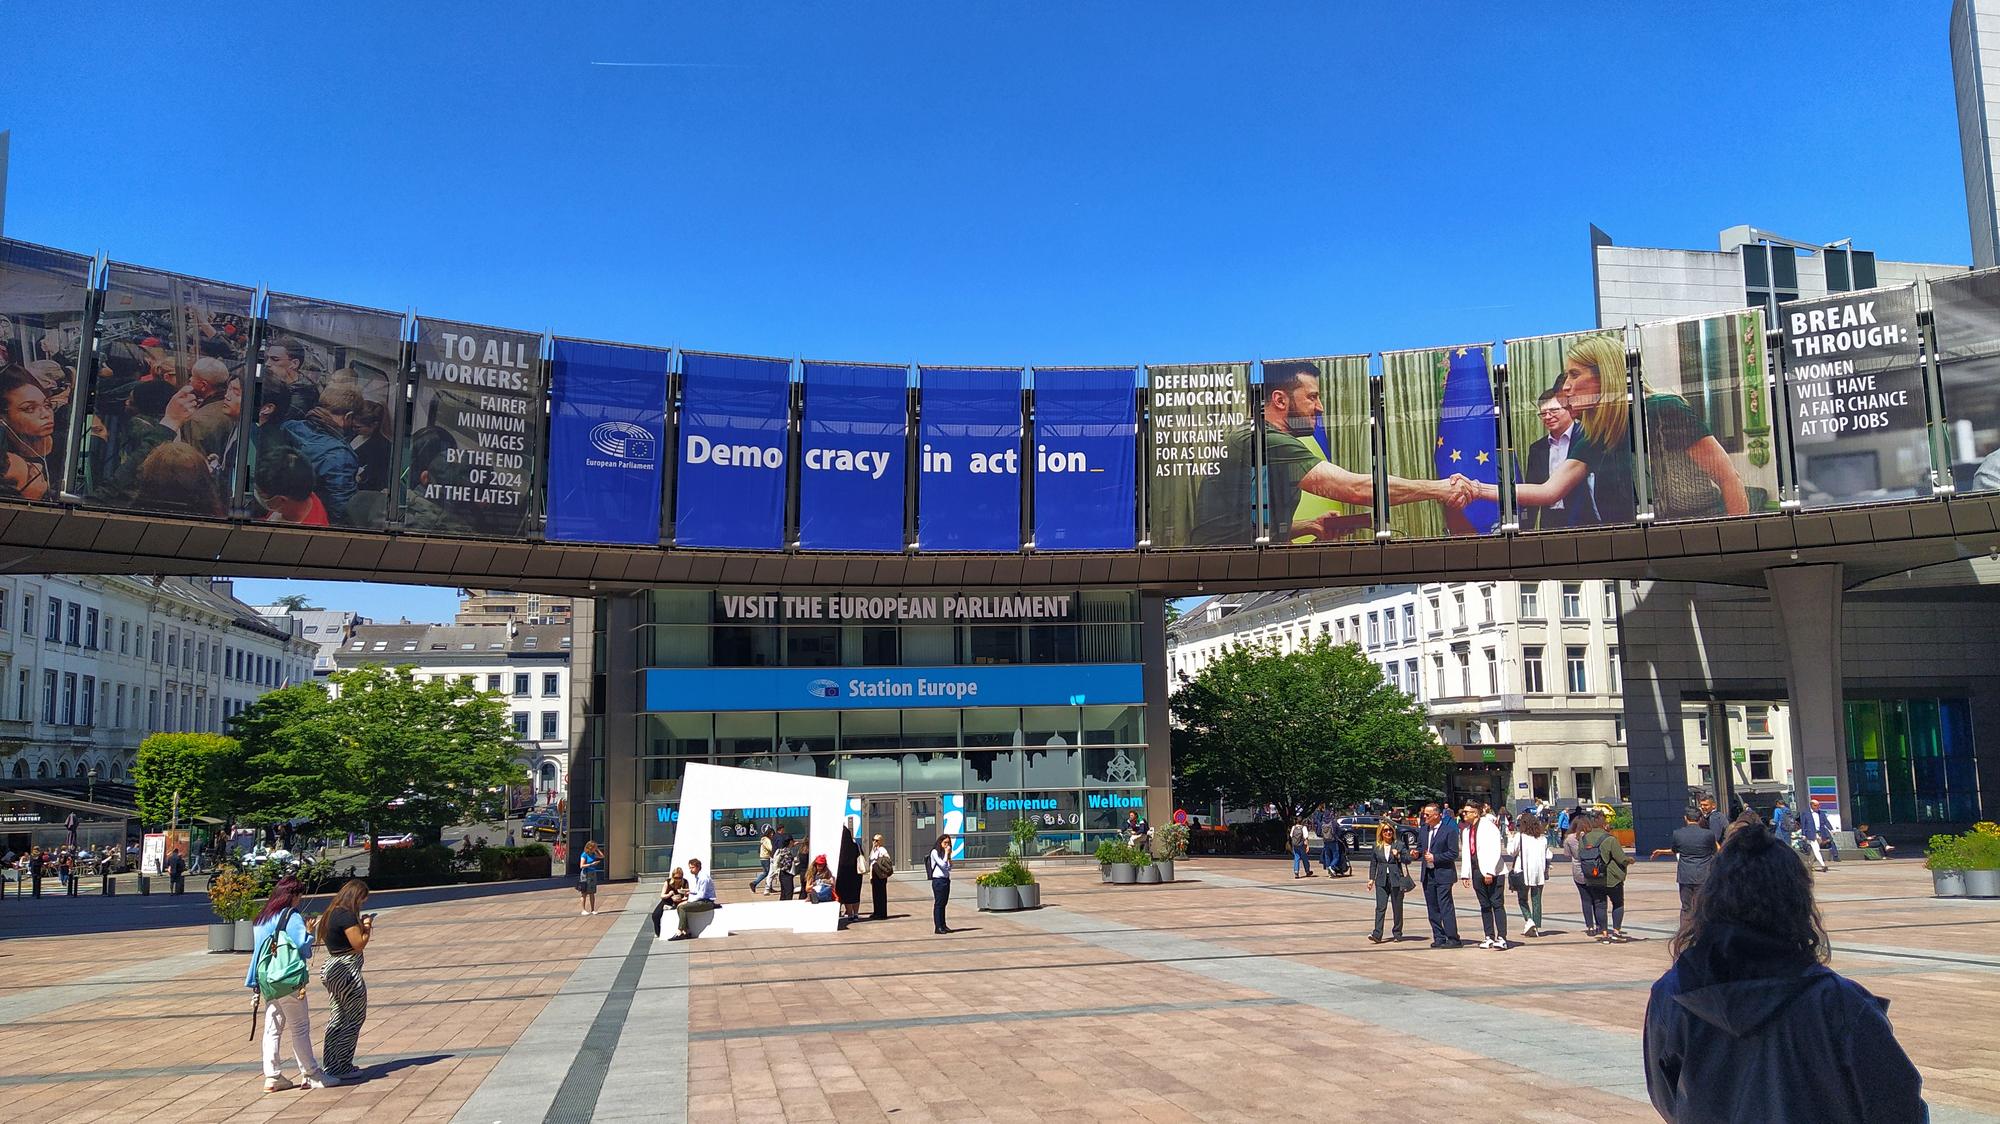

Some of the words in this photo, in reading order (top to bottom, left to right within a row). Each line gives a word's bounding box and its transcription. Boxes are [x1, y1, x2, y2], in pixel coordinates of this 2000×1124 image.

[1790, 301, 1877, 336] BREAK
[441, 333, 476, 362] TO
[482, 339, 529, 369] ALL
[1791, 324, 1907, 358] THROUGH:
[425, 360, 529, 392] WORKERS:
[1155, 373, 1234, 389] DEFENDING
[1794, 359, 1854, 381] WOMEN
[1155, 390, 1246, 407] DEMOCRACY:
[1796, 381, 1834, 400] WILL
[1836, 375, 1877, 395] HAVE
[480, 395, 527, 415] FAIRER
[1799, 403, 1810, 418] A
[1812, 398, 1846, 416] FAIR
[1848, 390, 1908, 412] CHANCE
[457, 411, 525, 433] MINIMUM
[1155, 414, 1173, 428] WE
[1175, 413, 1204, 427] WILL
[1206, 412, 1244, 426] STAND
[1801, 420, 1818, 436] AT
[1820, 417, 1849, 434] TOP
[1852, 411, 1889, 431] JOBS
[478, 432, 524, 451] WAGES
[1156, 431, 1171, 444] BY
[1173, 429, 1224, 444] UKRAINE
[446, 448, 465, 463] BY
[467, 450, 493, 467] THE
[495, 453, 523, 469] END
[686, 435, 783, 469] Demo
[805, 448, 891, 480] cracy
[923, 444, 952, 473] in
[969, 448, 1018, 474] act
[1156, 447, 1178, 460] FOR
[1180, 446, 1195, 460] AS
[1198, 445, 1228, 459] LONG
[586, 458, 617, 468] European
[618, 460, 654, 470] Parliament
[1155, 463, 1171, 477] AS
[1173, 463, 1184, 476] IT
[1185, 462, 1221, 476] TAKES
[469, 469, 487, 485] OF
[489, 471, 522, 487] 2024
[424, 484, 442, 498] AT
[444, 485, 470, 502] THE
[474, 489, 521, 506] LATEST
[723, 595, 778, 618] VISIT
[782, 596, 823, 619] THE
[828, 597, 937, 619] EUROPEAN
[943, 595, 1070, 618] PARLIAMENT
[848, 678, 913, 697] Station
[918, 678, 978, 700] Europe
[985, 796, 1058, 811] Bienvenue
[1087, 794, 1143, 809] Welkom
